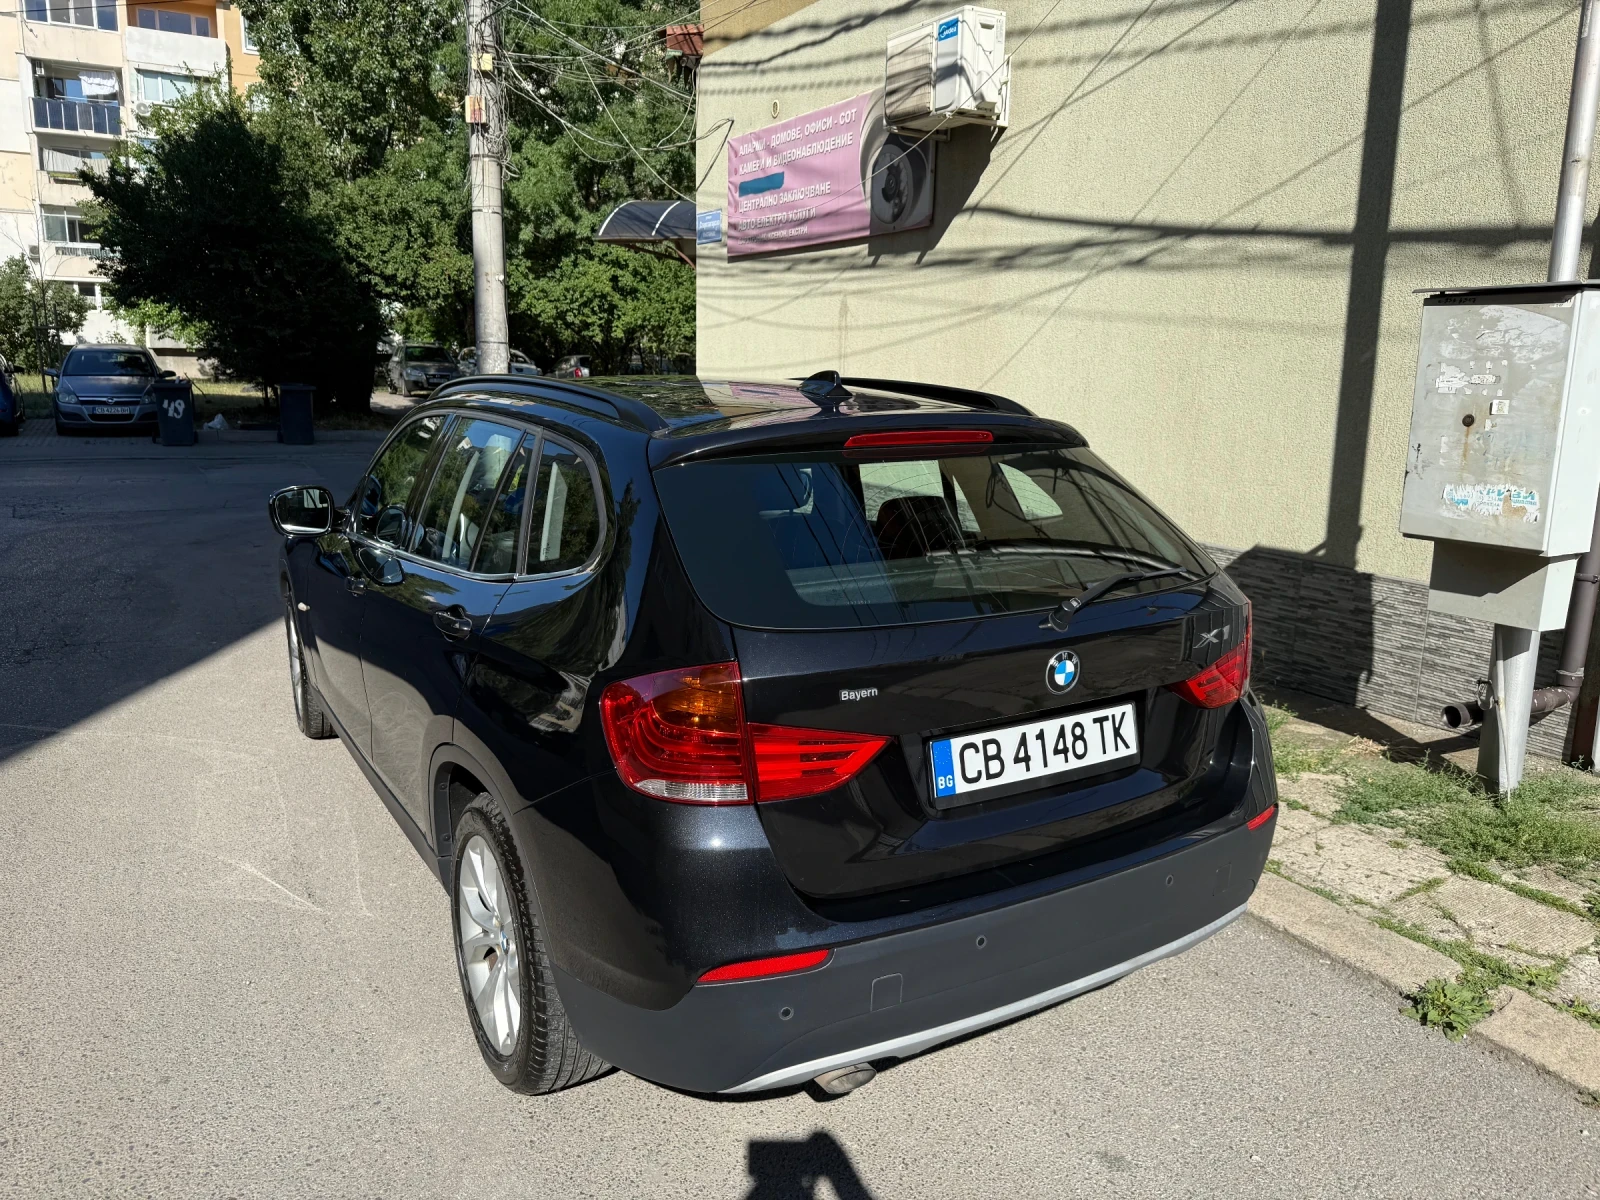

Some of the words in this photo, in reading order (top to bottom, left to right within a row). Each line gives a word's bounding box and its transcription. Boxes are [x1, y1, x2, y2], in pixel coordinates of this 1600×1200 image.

[770, 127, 803, 149] ДОМОВЕ,
[804, 115, 833, 137] ОФИСИ
[839, 108, 858, 126] СОТ
[738, 156, 766, 176] КАМЕРИ
[766, 157, 772, 169] И
[773, 131, 854, 167] ВИДЕОНАБЛЮДЕНИЕ
[738, 194, 778, 215] ЦЕНТРАЛНО
[779, 181, 831, 204] ЗАКЛЮЧВАНЕ
[1193, 625, 1230, 648] X1
[840, 686, 878, 702] Bayern
[958, 737, 1005, 785] CB
[1013, 721, 1088, 773] 4148
[1092, 711, 1131, 756] TK
[937, 775, 954, 791] BG
